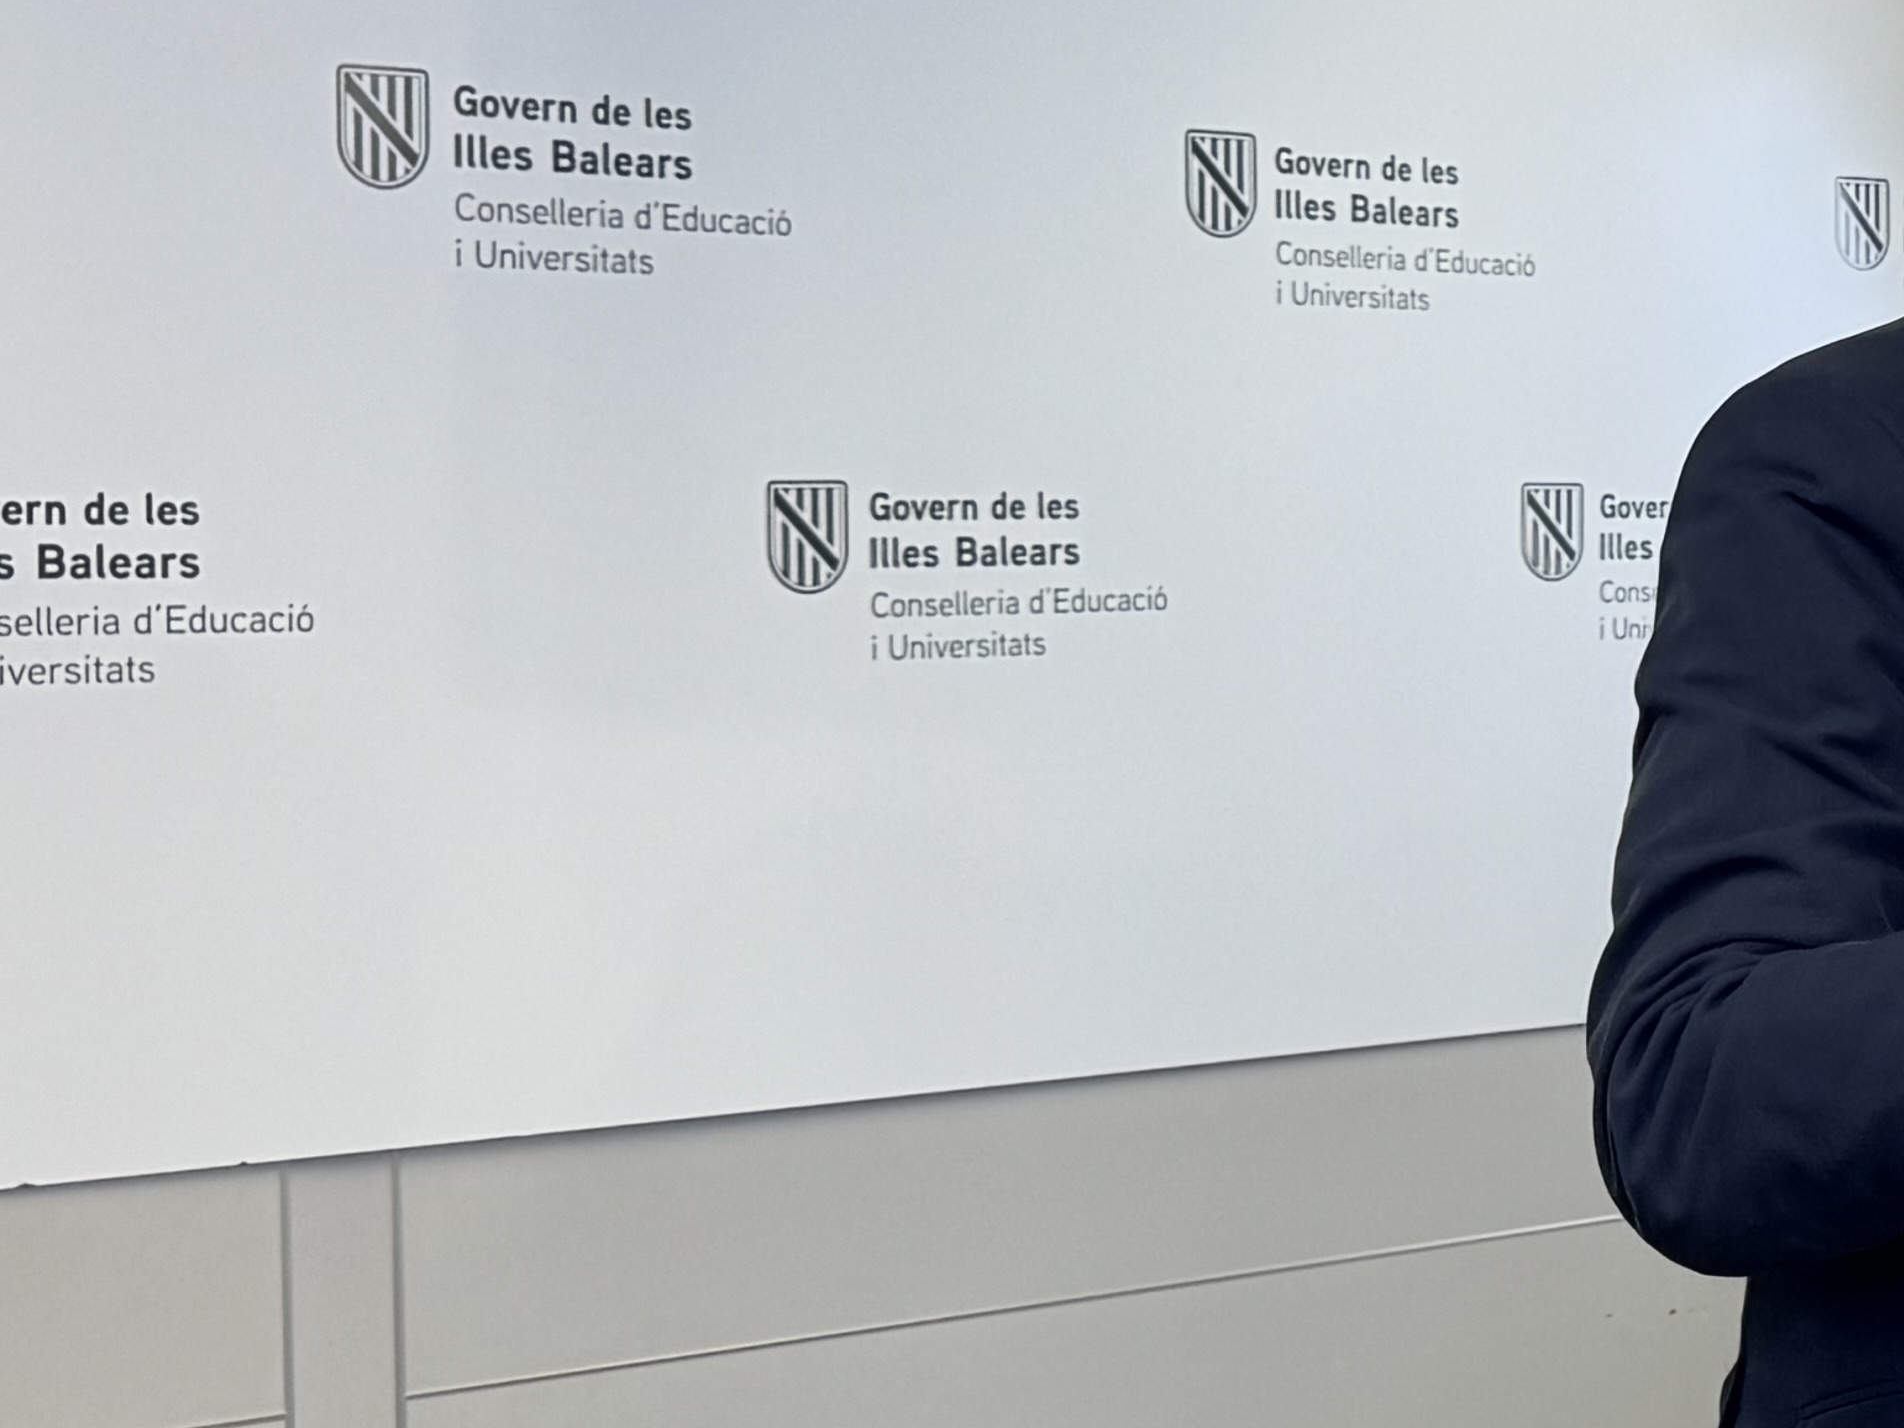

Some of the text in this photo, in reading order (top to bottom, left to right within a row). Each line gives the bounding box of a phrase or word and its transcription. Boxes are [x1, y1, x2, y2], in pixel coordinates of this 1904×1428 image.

[454, 85, 692, 130] Govern de les
[454, 134, 693, 180] Illes Balears
[1275, 147, 1459, 185] Govern de les
[454, 193, 792, 236] Conselleria d'Educació
[1275, 189, 1459, 228] Illes Balears
[455, 239, 654, 274] i Universitats
[1276, 240, 1536, 277] Conselleria d'Educació
[1276, 280, 1430, 311] i Universitats
[1, 492, 200, 525] ern de les
[870, 492, 1080, 521] Govern de les
[1600, 493, 1669, 519] Gover
[38, 544, 200, 580] Balears
[869, 536, 1081, 569] Illes Balears
[1599, 533, 1653, 560] Illes
[870, 586, 1168, 619] Conselleria d'Educació
[0, 603, 315, 636] selleria d'Educació
[871, 631, 1046, 661] i Universitats
[0, 654, 155, 685] iversitats
